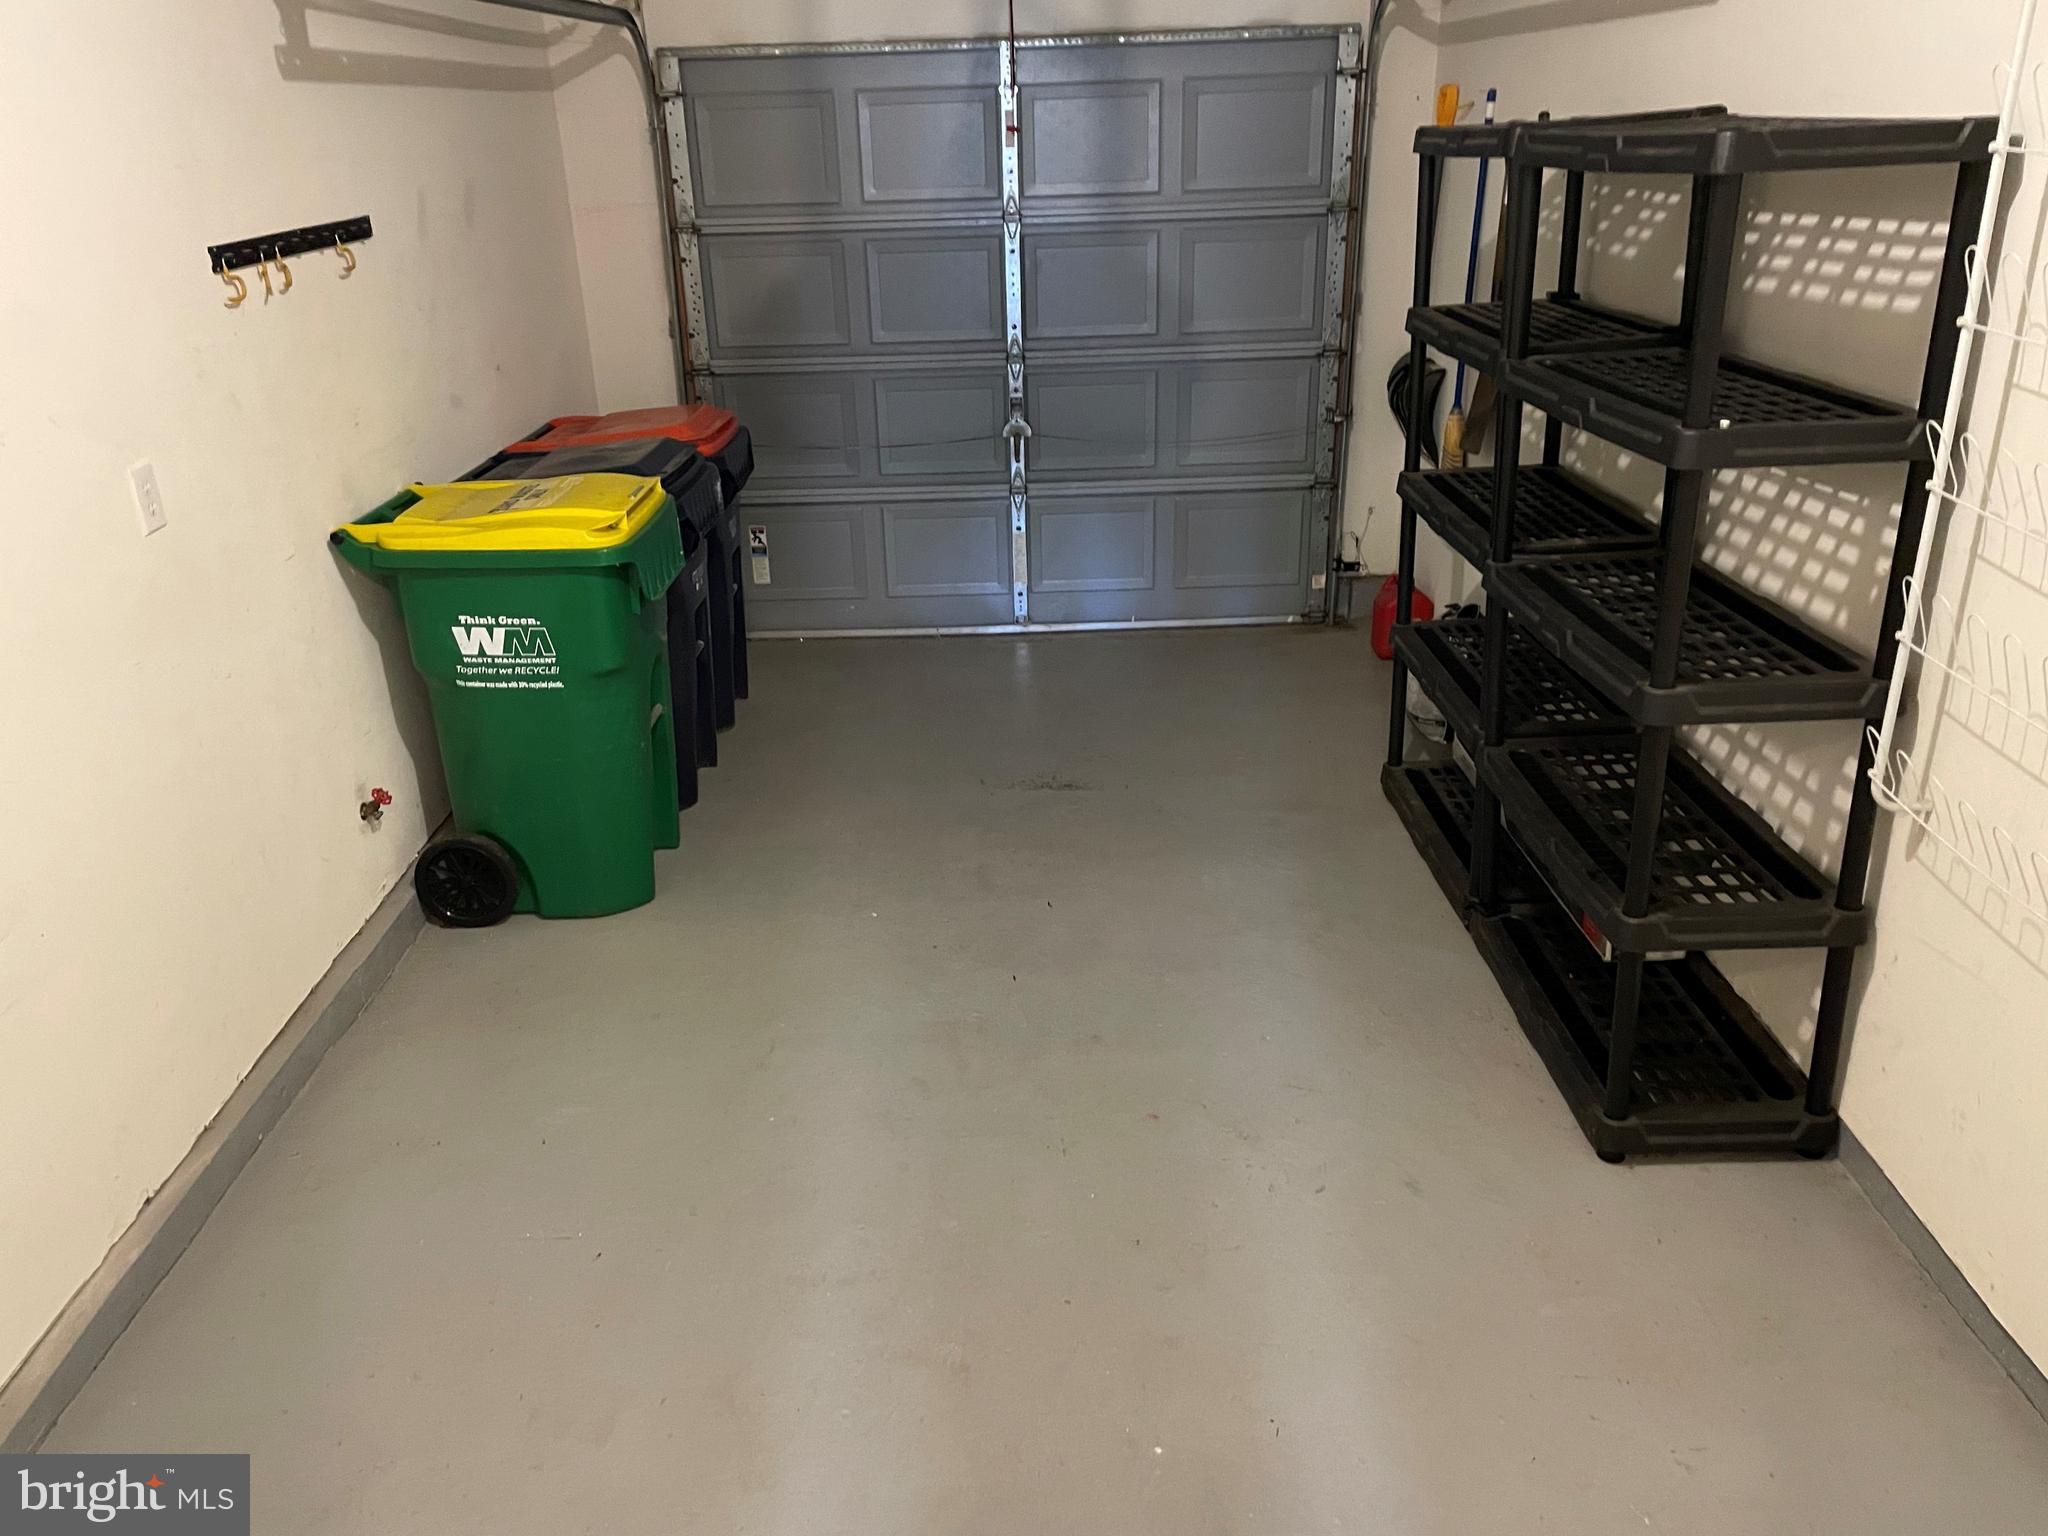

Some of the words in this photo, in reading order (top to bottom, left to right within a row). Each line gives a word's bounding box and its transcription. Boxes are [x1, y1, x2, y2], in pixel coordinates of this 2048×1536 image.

[458, 615, 496, 625] Think
[498, 616, 541, 625] Green.
[451, 626, 556, 656] WM
[463, 656, 493, 664] WASTE
[456, 665, 497, 676] Together
[514, 666, 560, 675] RECYCLE!
